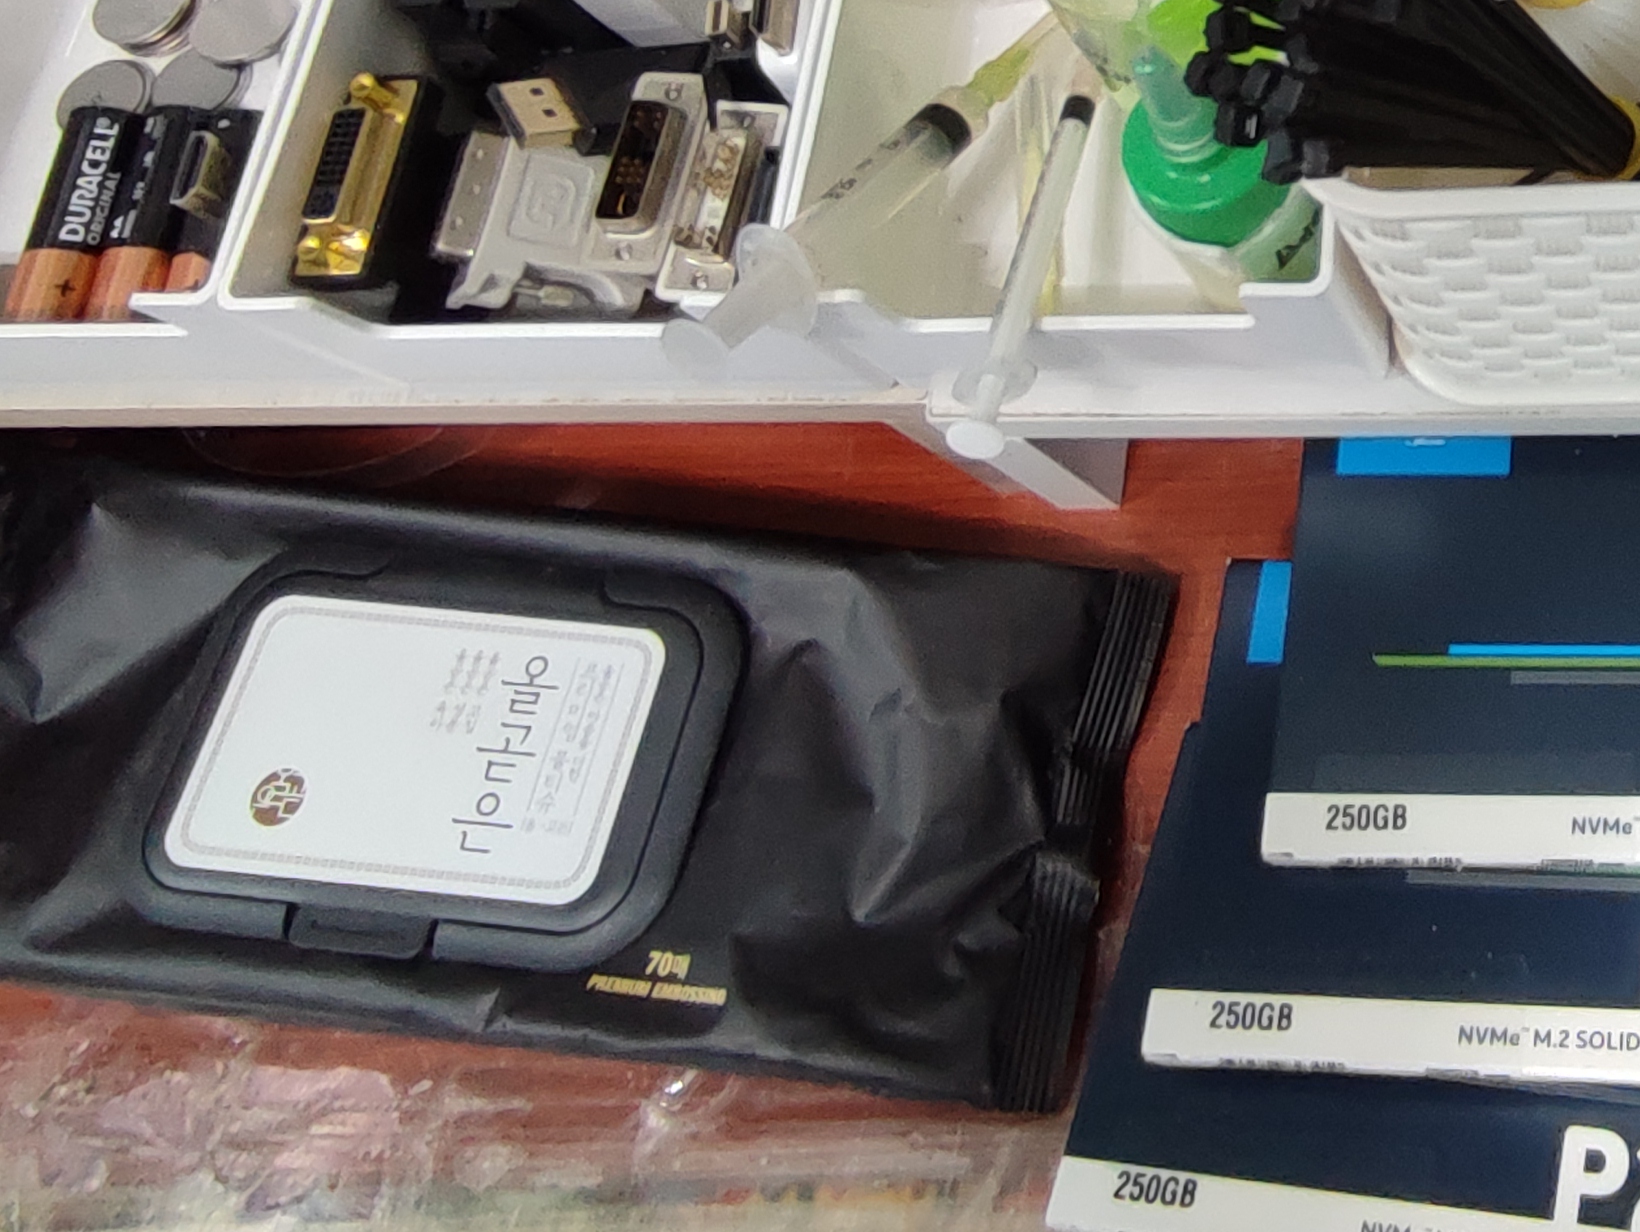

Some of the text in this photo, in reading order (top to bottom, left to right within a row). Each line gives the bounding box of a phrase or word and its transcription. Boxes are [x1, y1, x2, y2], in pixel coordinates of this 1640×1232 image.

[58, 121, 120, 243] DURACELL
[87, 171, 122, 245] ORIGINAL
[451, 654, 560, 856] 올곧은
[1325, 801, 1409, 834] 250GB
[1208, 1000, 1293, 1032] 250GB
[1533, 1025, 1573, 1050] M.2
[1574, 1028, 1640, 1052] SOLID
[1113, 1168, 1199, 1210] 250GB
